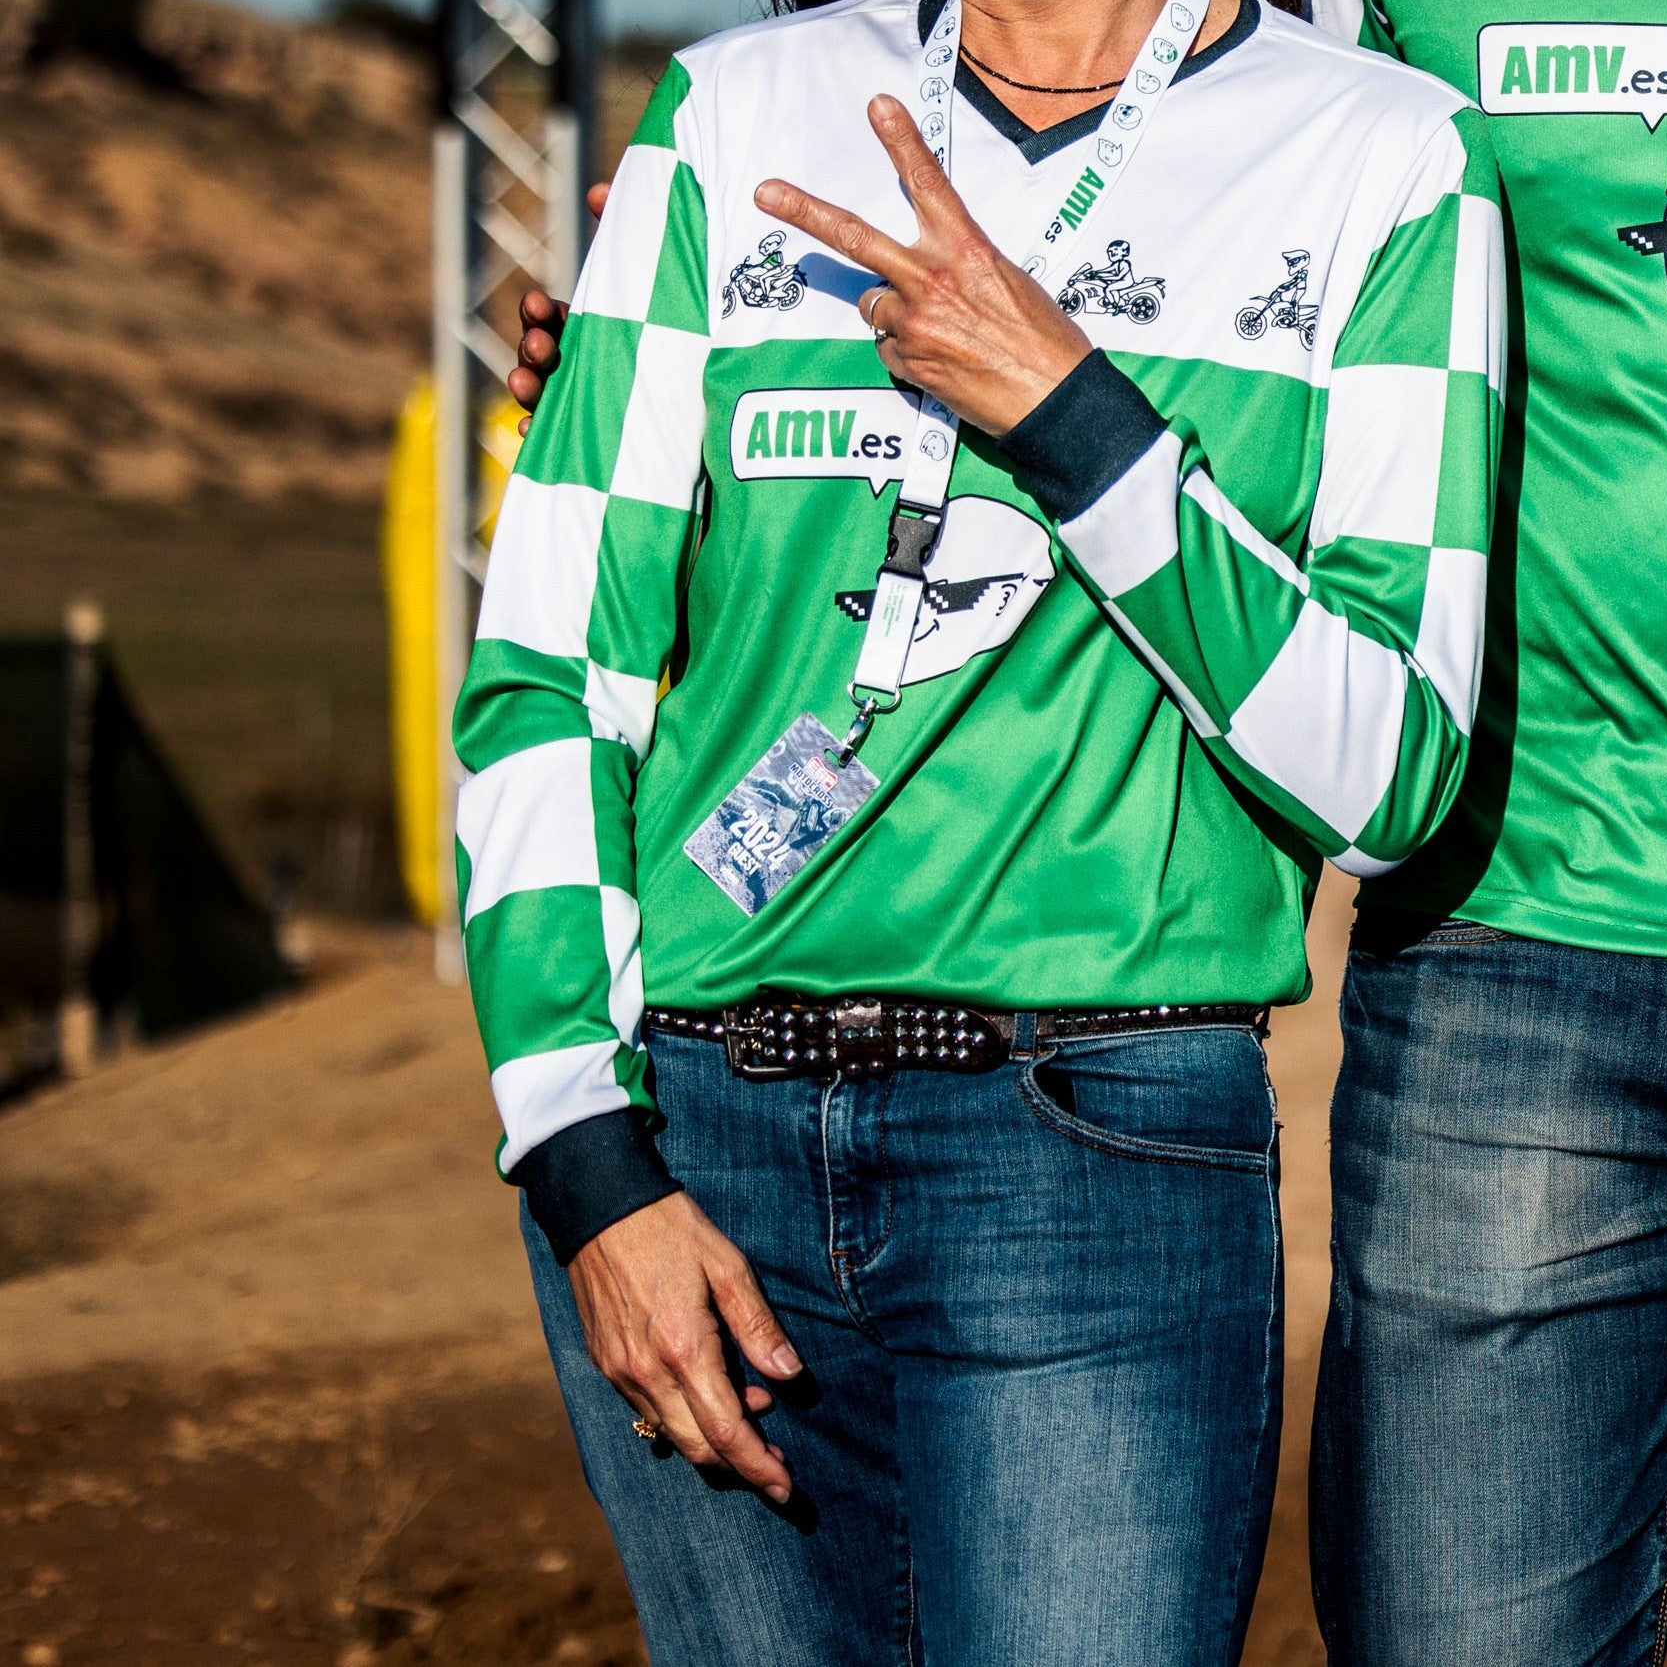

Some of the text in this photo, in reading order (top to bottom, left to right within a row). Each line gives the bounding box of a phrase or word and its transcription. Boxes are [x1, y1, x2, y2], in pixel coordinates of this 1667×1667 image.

[789, 762, 835, 808] MOTOCROSS
[728, 841, 761, 876] GUEST
[729, 810, 791, 872] 2024
